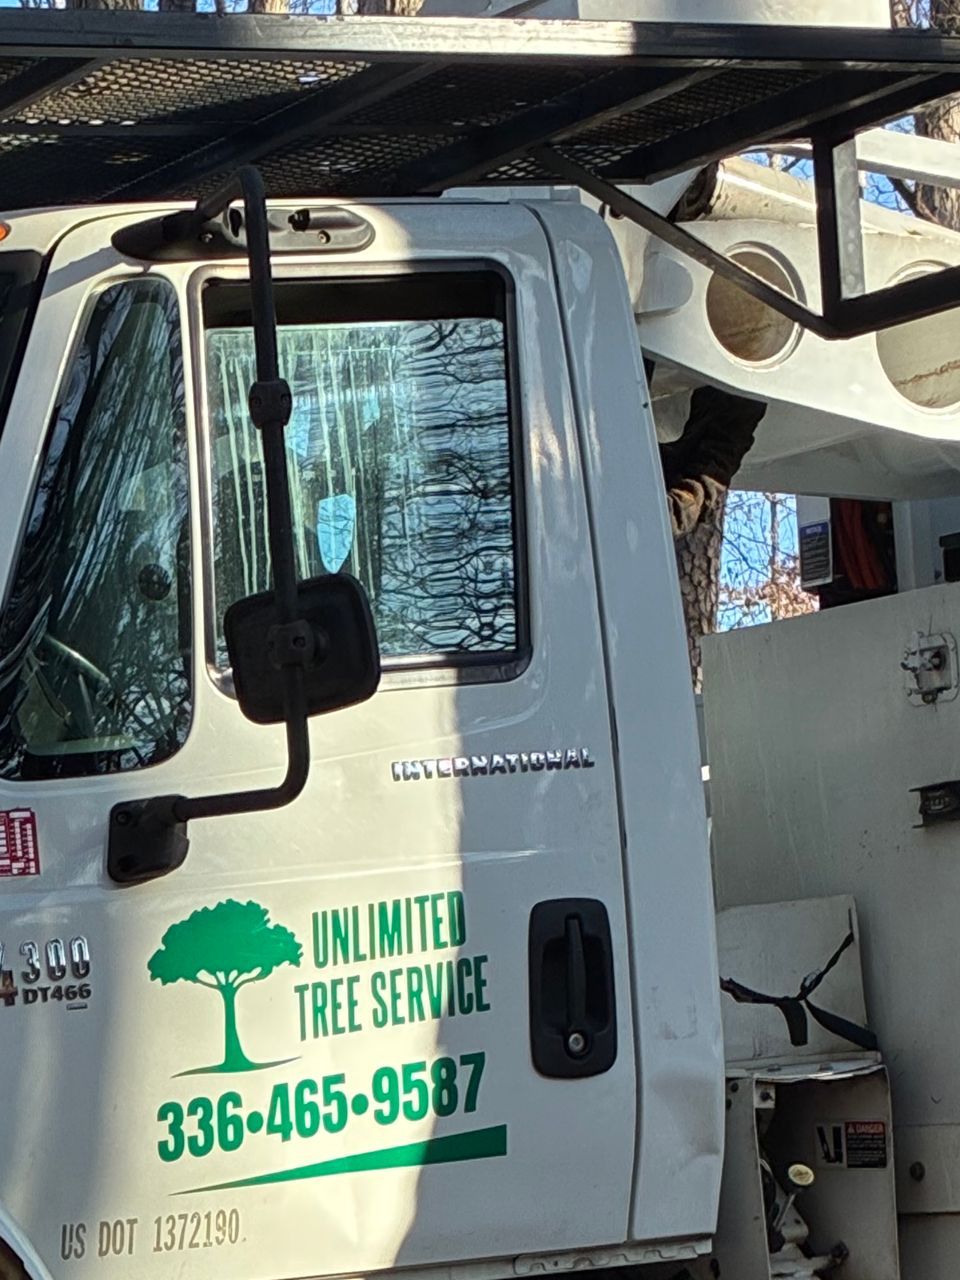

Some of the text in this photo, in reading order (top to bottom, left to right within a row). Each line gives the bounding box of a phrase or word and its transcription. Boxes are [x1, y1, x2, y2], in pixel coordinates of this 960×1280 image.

[392, 748, 595, 781] INTERNATIONAL
[312, 891, 466, 968] UNLIMITED
[22, 984, 92, 1005] DT466
[294, 955, 490, 1042] TREE SERVICE
[61, 1223, 87, 1260] US
[98, 1218, 138, 1257] DOT
